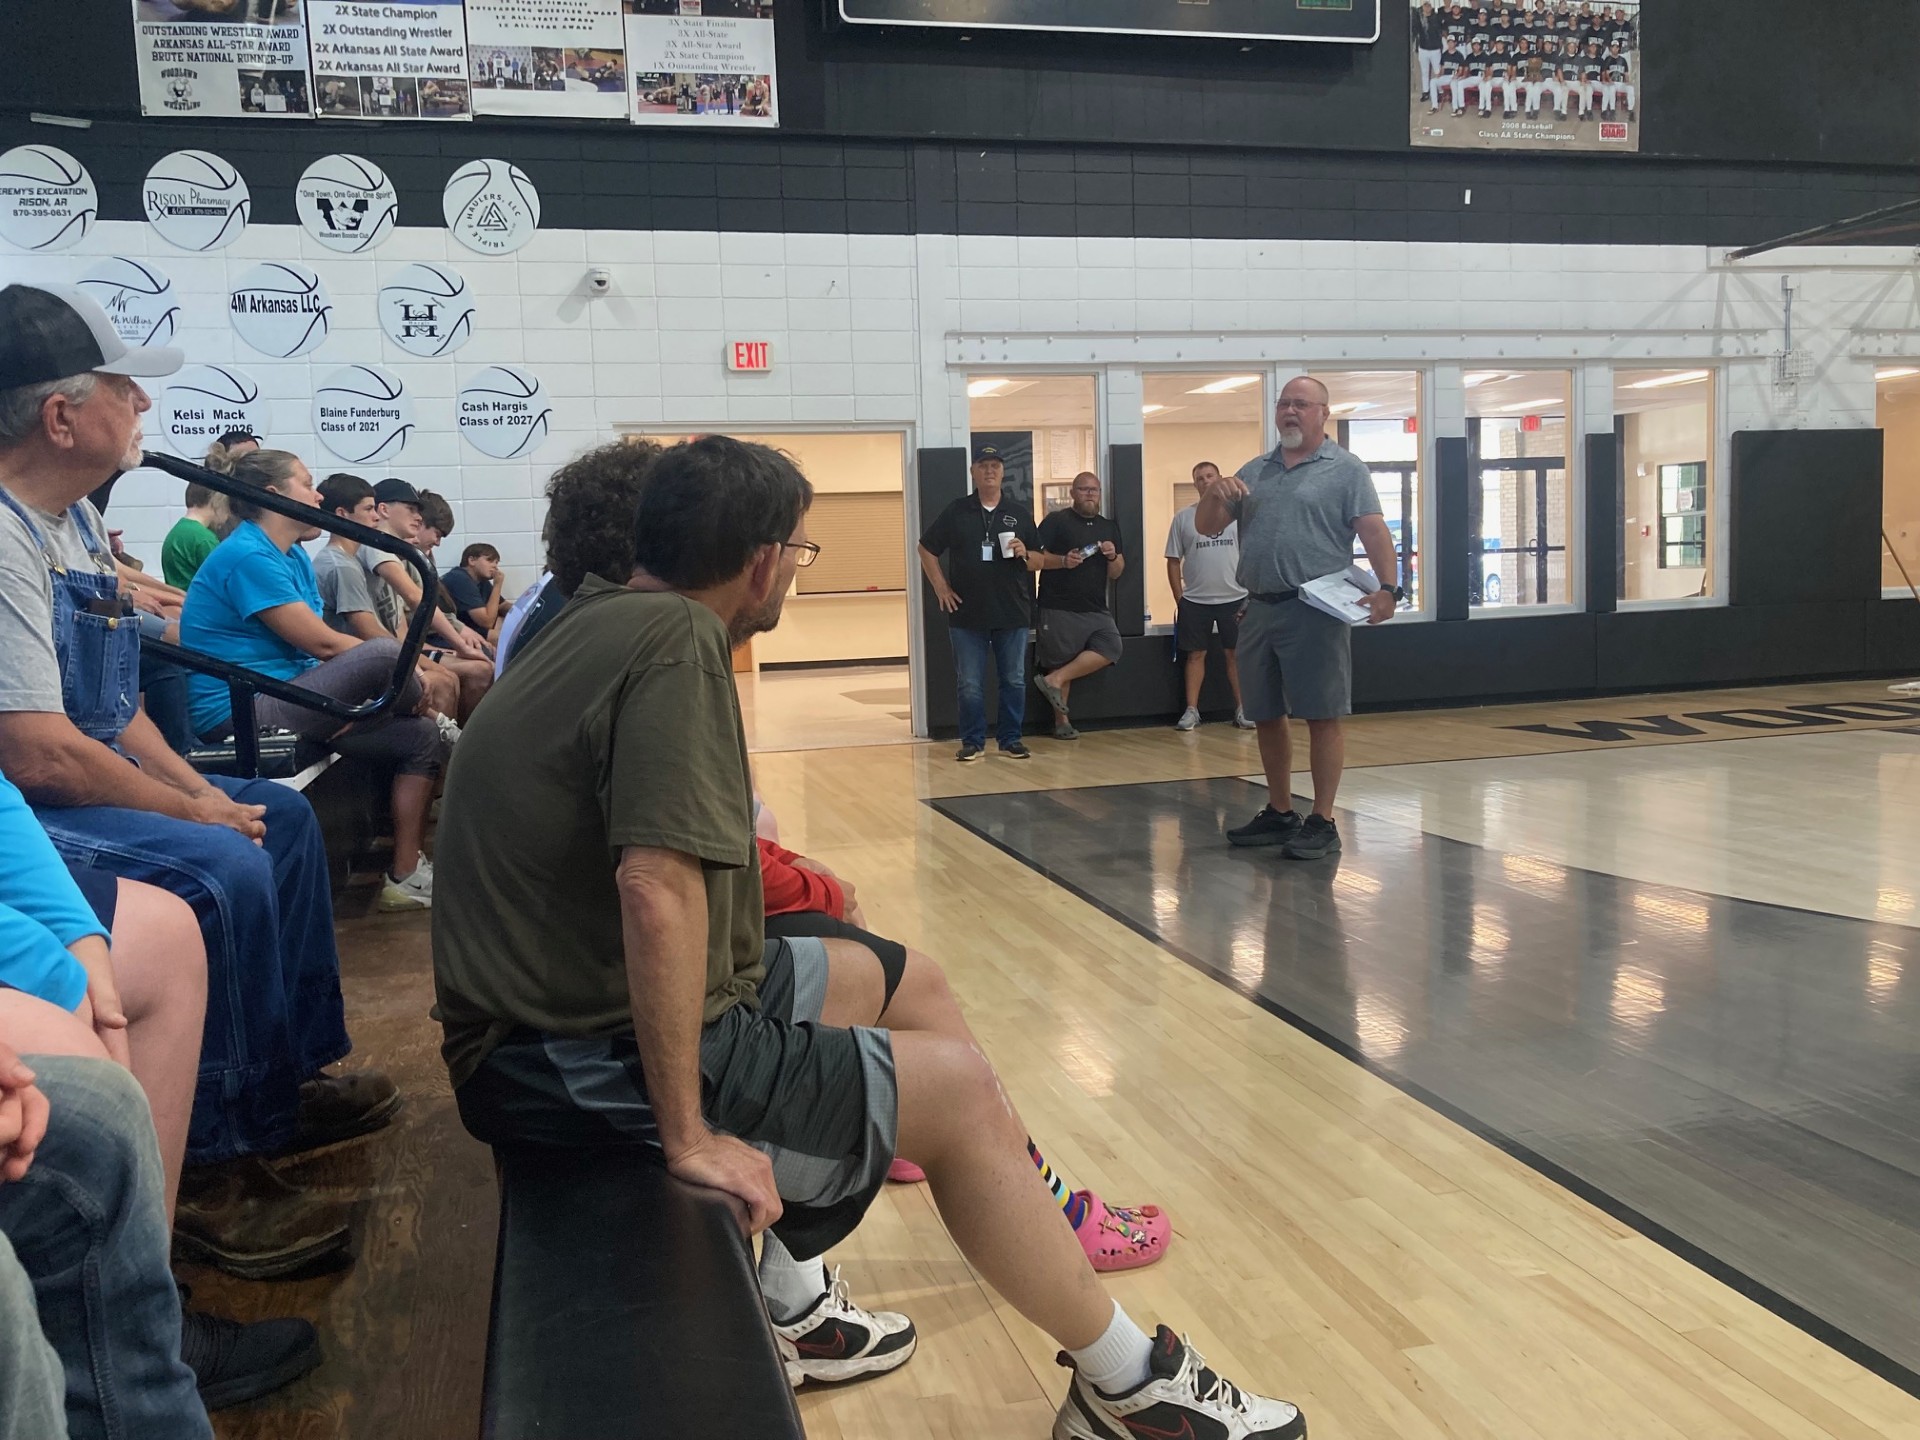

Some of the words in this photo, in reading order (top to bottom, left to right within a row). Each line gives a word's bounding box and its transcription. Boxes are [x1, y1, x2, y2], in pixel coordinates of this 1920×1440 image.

[335, 5, 349, 16] 2X
[352, 6, 380, 18] State
[382, 7, 437, 21] Champion
[683, 19, 704, 27] State
[706, 19, 736, 28] Finalist
[142, 25, 208, 36] OUTSTANDING
[210, 26, 263, 38] WRESTLER
[265, 28, 299, 39] AWARD
[322, 24, 336, 35] 2X
[339, 25, 407, 40] Outstanding
[408, 27, 453, 38] Wrestler
[693, 30, 728, 38] All-State
[153, 39, 204, 49] ARKANSAS
[206, 39, 254, 50] ALL-STAR
[257, 41, 291, 52] AWARD
[315, 43, 329, 53] 2X
[332, 44, 381, 55] Arkansas
[383, 45, 397, 56] All
[400, 46, 427, 56] State
[429, 46, 463, 57] Award
[681, 40, 712, 49] All-Star
[716, 41, 741, 49] Award
[152, 51, 184, 62] BRUTE
[186, 52, 234, 63] NATIONAL
[237, 53, 294, 64] RUNNER-UP
[679, 51, 700, 59] State
[702, 52, 744, 61] Champion
[318, 60, 332, 70] 2X
[335, 61, 384, 72] Arkansas
[386, 62, 400, 73] All
[403, 63, 424, 73] Star
[426, 63, 460, 74] Award
[667, 62, 718, 71] Outstanding
[721, 63, 756, 72] Wrestler
[160, 67, 198, 79] WOODLAWN
[1521, 122, 1553, 130] Baseball
[1478, 130, 1499, 138] Class
[1513, 131, 1533, 139] State
[1535, 132, 1575, 141] Champions
[36, 188, 88, 196] EXCAVATION
[334, 190, 346, 198] One
[19, 198, 51, 207] RISON,
[54, 198, 68, 206] AR
[190, 187, 231, 209] Pharmacy
[471, 231, 505, 248] TRIPLE
[507, 200, 521, 217] LLC
[231, 294, 247, 313] 4M
[250, 294, 298, 313] Arkansas
[301, 294, 320, 313] LLC
[735, 342, 768, 368] EXIT
[461, 402, 489, 412] Cash
[492, 401, 528, 413] Hargis
[173, 409, 205, 420] Kelsi
[213, 409, 246, 420] Mack
[320, 407, 348, 418] Blaine
[350, 408, 400, 420] Funderburg
[459, 416, 490, 426] Class
[493, 416, 504, 426] of
[507, 416, 533, 426] 2027
[171, 424, 205, 435] Class
[208, 424, 220, 435] of
[321, 422, 345, 432] Class
[347, 422, 358, 432] of
[359, 422, 380, 432] 2021
